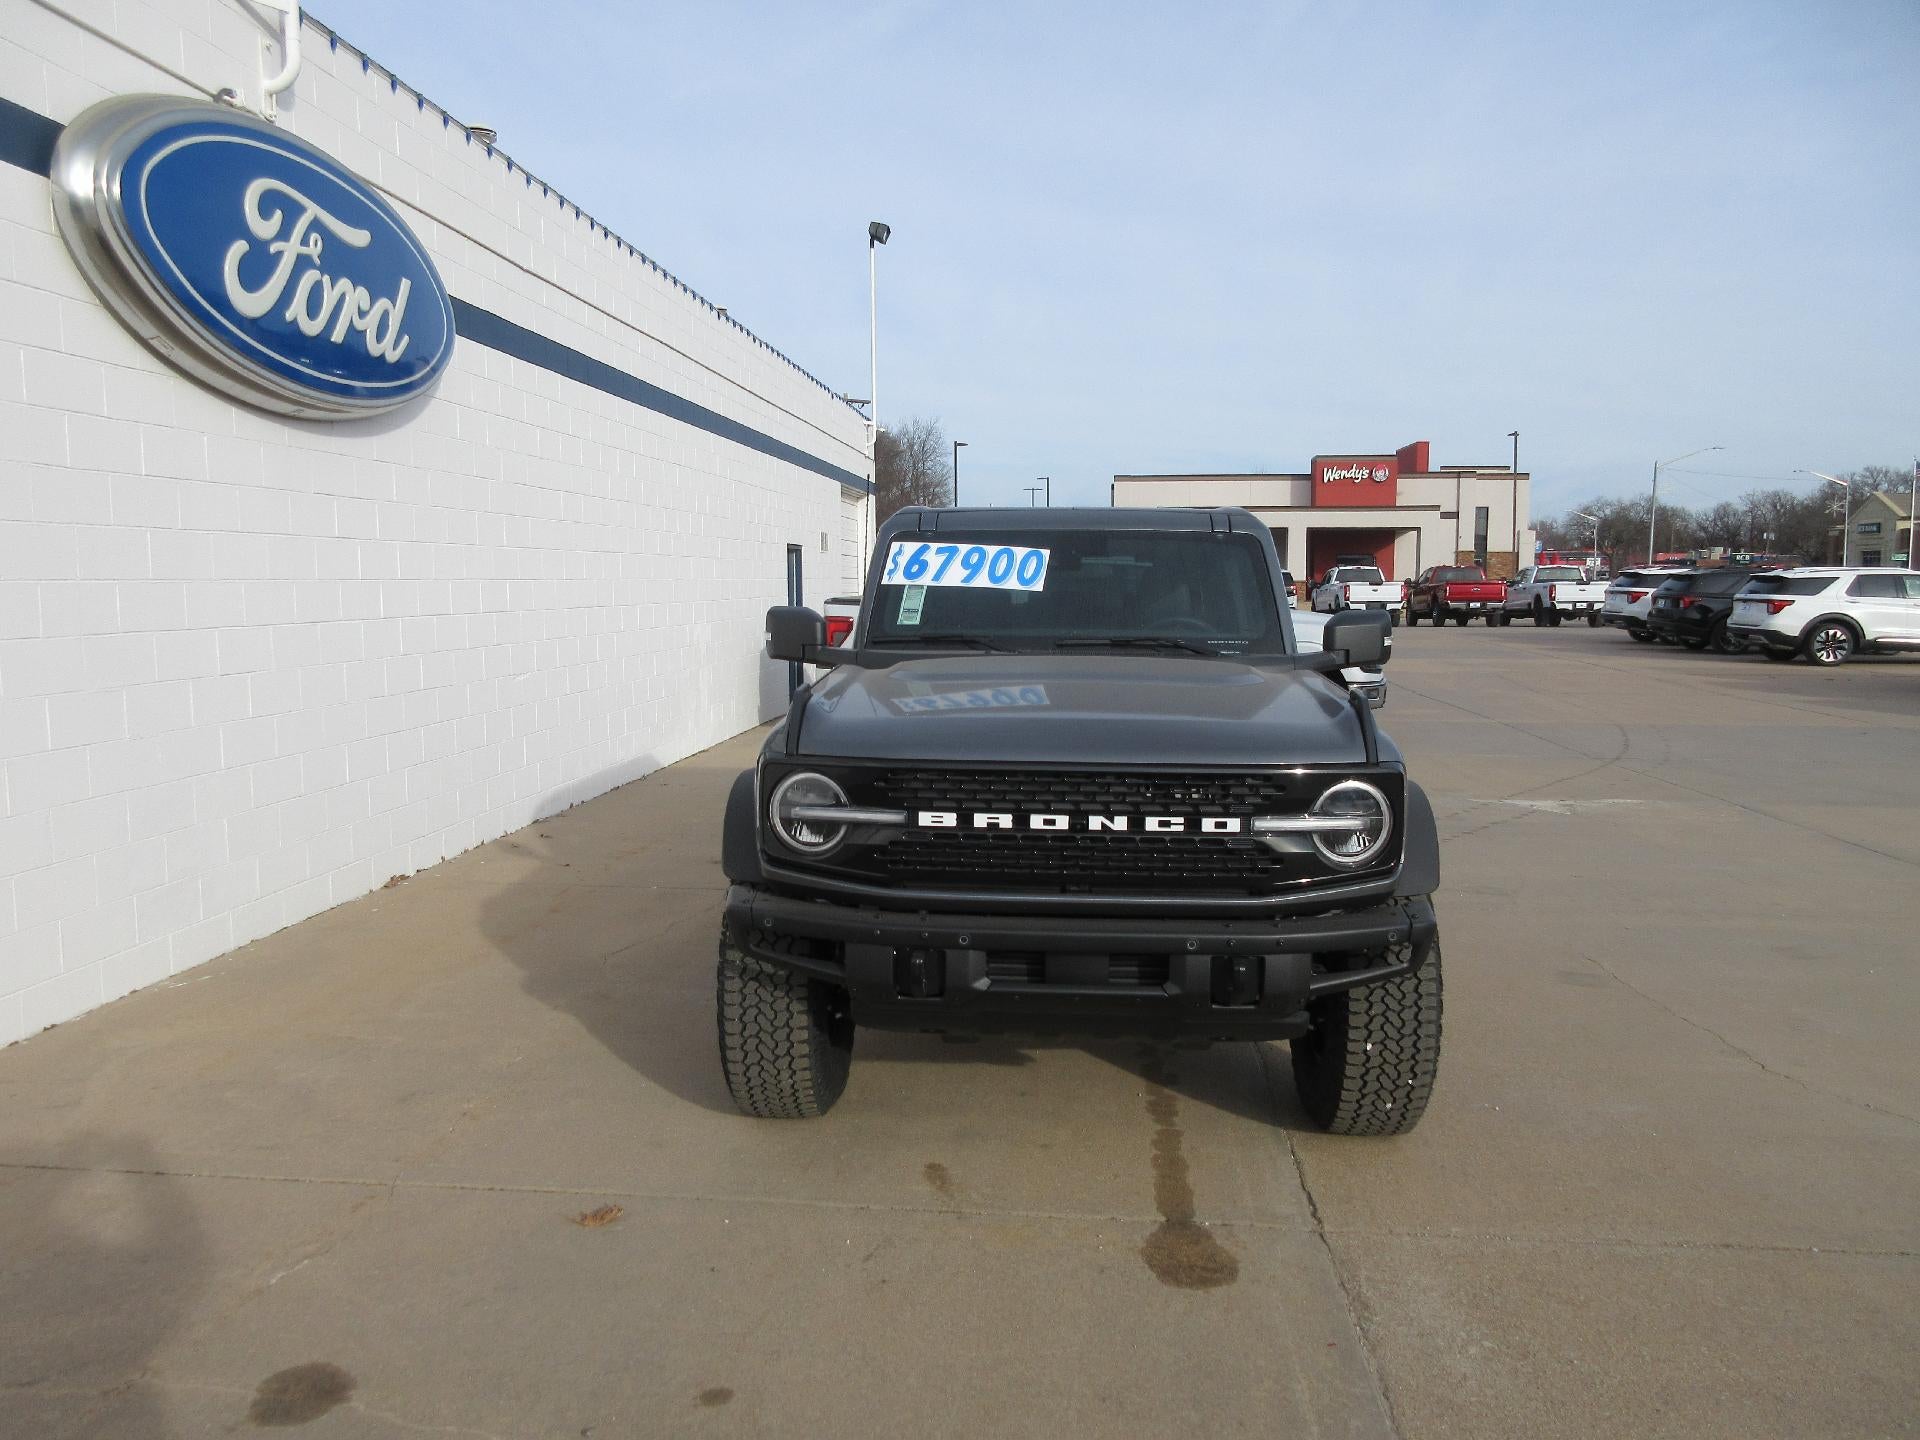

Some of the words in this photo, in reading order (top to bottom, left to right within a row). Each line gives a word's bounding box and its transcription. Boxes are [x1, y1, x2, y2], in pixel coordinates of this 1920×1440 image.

[223, 176, 411, 364] Ford
[1322, 463, 1370, 483] Wendy's
[886, 543, 1047, 588] $67900
[917, 810, 1242, 833] BRONCO
